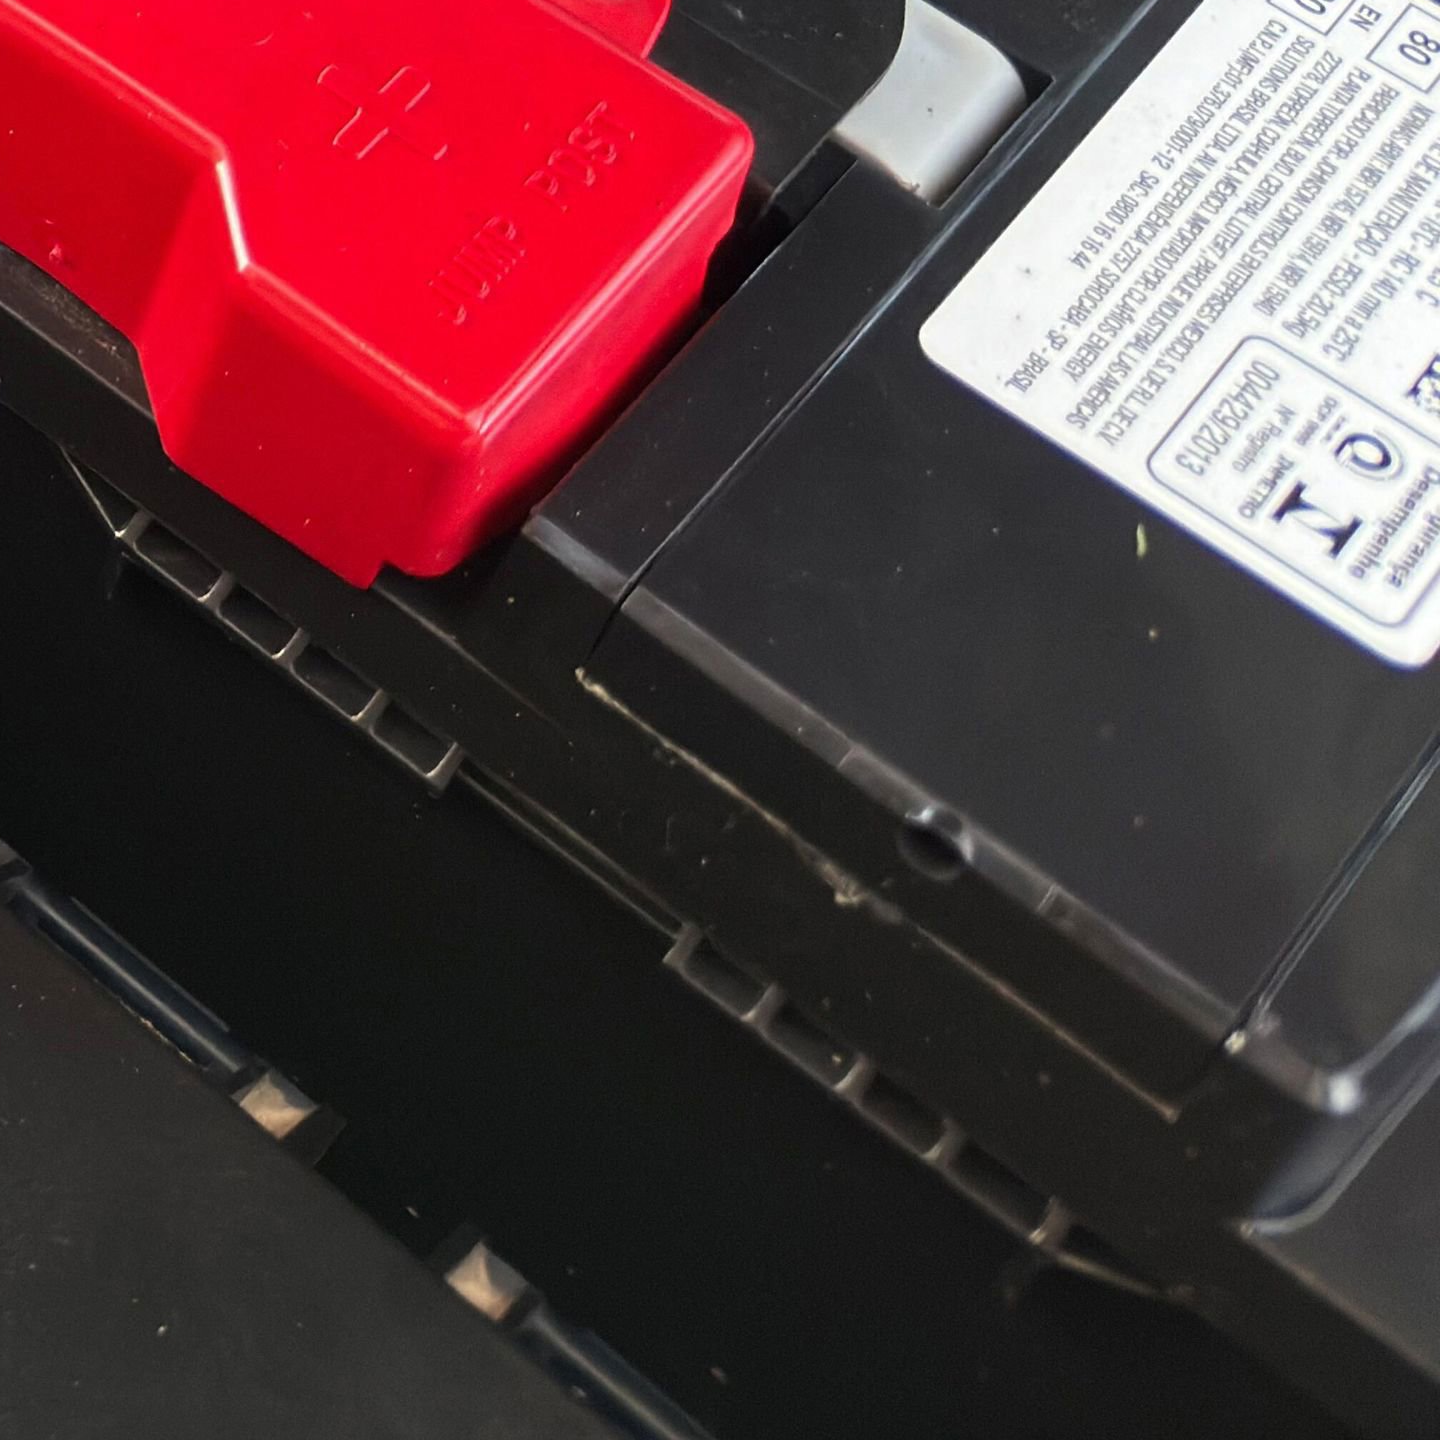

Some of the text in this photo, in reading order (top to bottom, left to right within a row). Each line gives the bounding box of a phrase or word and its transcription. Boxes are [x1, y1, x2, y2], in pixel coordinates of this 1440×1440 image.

[1348, 0, 1382, 35] EN
[1256, 31, 1316, 97] SOLUTIONS
[1394, 24, 1440, 73] 80
[1227, 85, 1271, 132] BRASIL
[1264, 76, 1321, 138] TORREÓN,
[1328, 63, 1372, 110] PLANTA
[1344, 80, 1402, 143] FABRICADO
[1203, 120, 1242, 161] LTDA.
[1288, 96, 1347, 160] TORREÓN,
[1325, 131, 1360, 165] POR:
[1387, 97, 1436, 149] NORMAS
[1225, 121, 1281, 182] COAHUILA,
[1269, 143, 1306, 183] BLVD.
[1125, 167, 1159, 202] SAC:
[1128, 163, 1209, 253] INDEPENDÊNCIA
[1233, 171, 1284, 225] CENTRAL
[1288, 153, 1341, 210] JOHNSON
[426, 99, 637, 326] JUMP POST
[1104, 191, 1140, 228] 0800
[1246, 198, 1304, 262] CONTROLS
[1107, 237, 1143, 274] 2757
[1152, 208, 1210, 273] IMPORTADO
[1386, 245, 1420, 278] RC
[1060, 264, 1121, 331] SOROCABA
[1133, 261, 1166, 295] POR:
[1169, 252, 1217, 303] PARQUE
[1194, 249, 1263, 326] ENTERPRISES
[1316, 253, 1364, 304] PESO:
[1368, 269, 1401, 302] 140
[1123, 291, 1185, 360] INDUSTRIAL
[1279, 287, 1335, 345] 20,5kg
[1349, 288, 1385, 325] min
[1002, 348, 1049, 398] BRASIL
[1059, 328, 1110, 384] ENERGY
[1106, 348, 1138, 380] LAS
[1063, 368, 1124, 434] AMÉRICAS
[1170, 355, 1283, 481] 004429/2013
[1225, 415, 1283, 477] Registro
[1233, 451, 1296, 522] INMETRO
